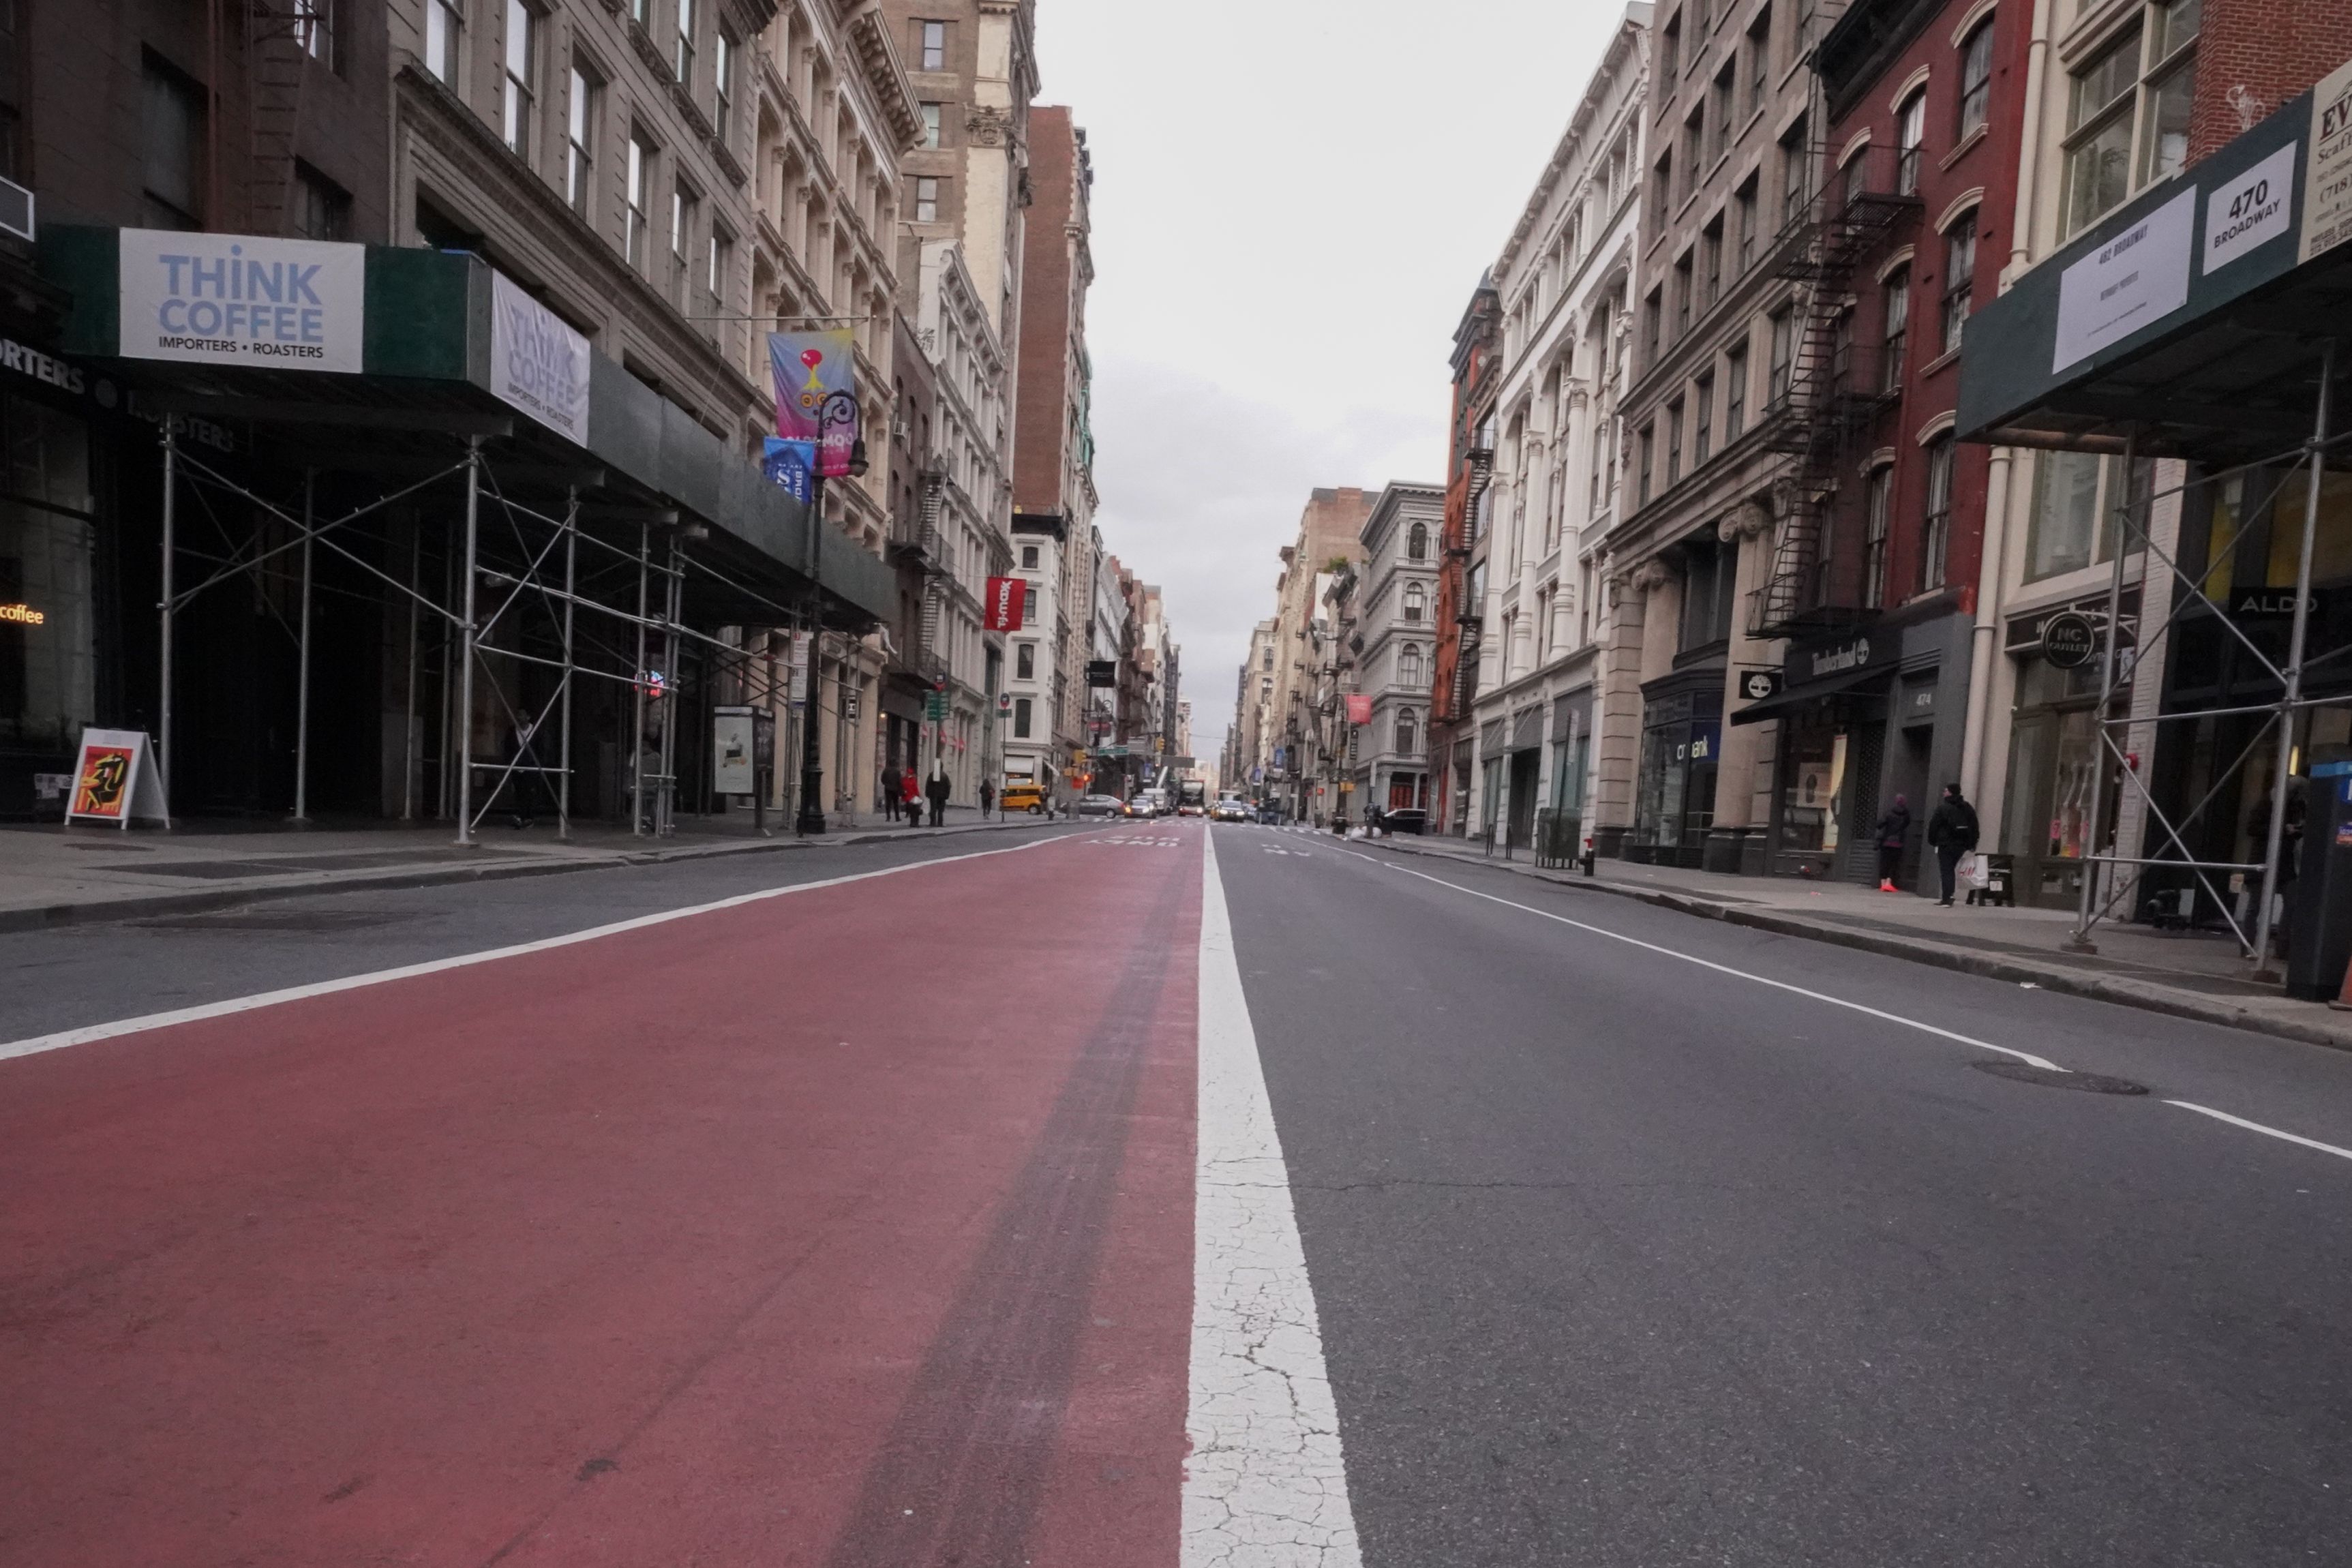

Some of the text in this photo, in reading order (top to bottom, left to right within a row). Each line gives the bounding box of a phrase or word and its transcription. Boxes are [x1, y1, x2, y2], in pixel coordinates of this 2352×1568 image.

[2229, 179, 2268, 220] 470
[2113, 224, 2148, 258] BROADWAY
[2214, 198, 2281, 250] BROADWAY
[159, 298, 324, 343] COFFEE
[159, 336, 324, 359] IMPORTERS ROASTERS
[0, 338, 86, 395] RTERS
[509, 349, 576, 416] COFFEE
[0, 604, 45, 624] coffee
[2049, 642, 2090, 653] OUTLET
[2057, 627, 2083, 642] NC
[1916, 693, 1931, 706] 474
